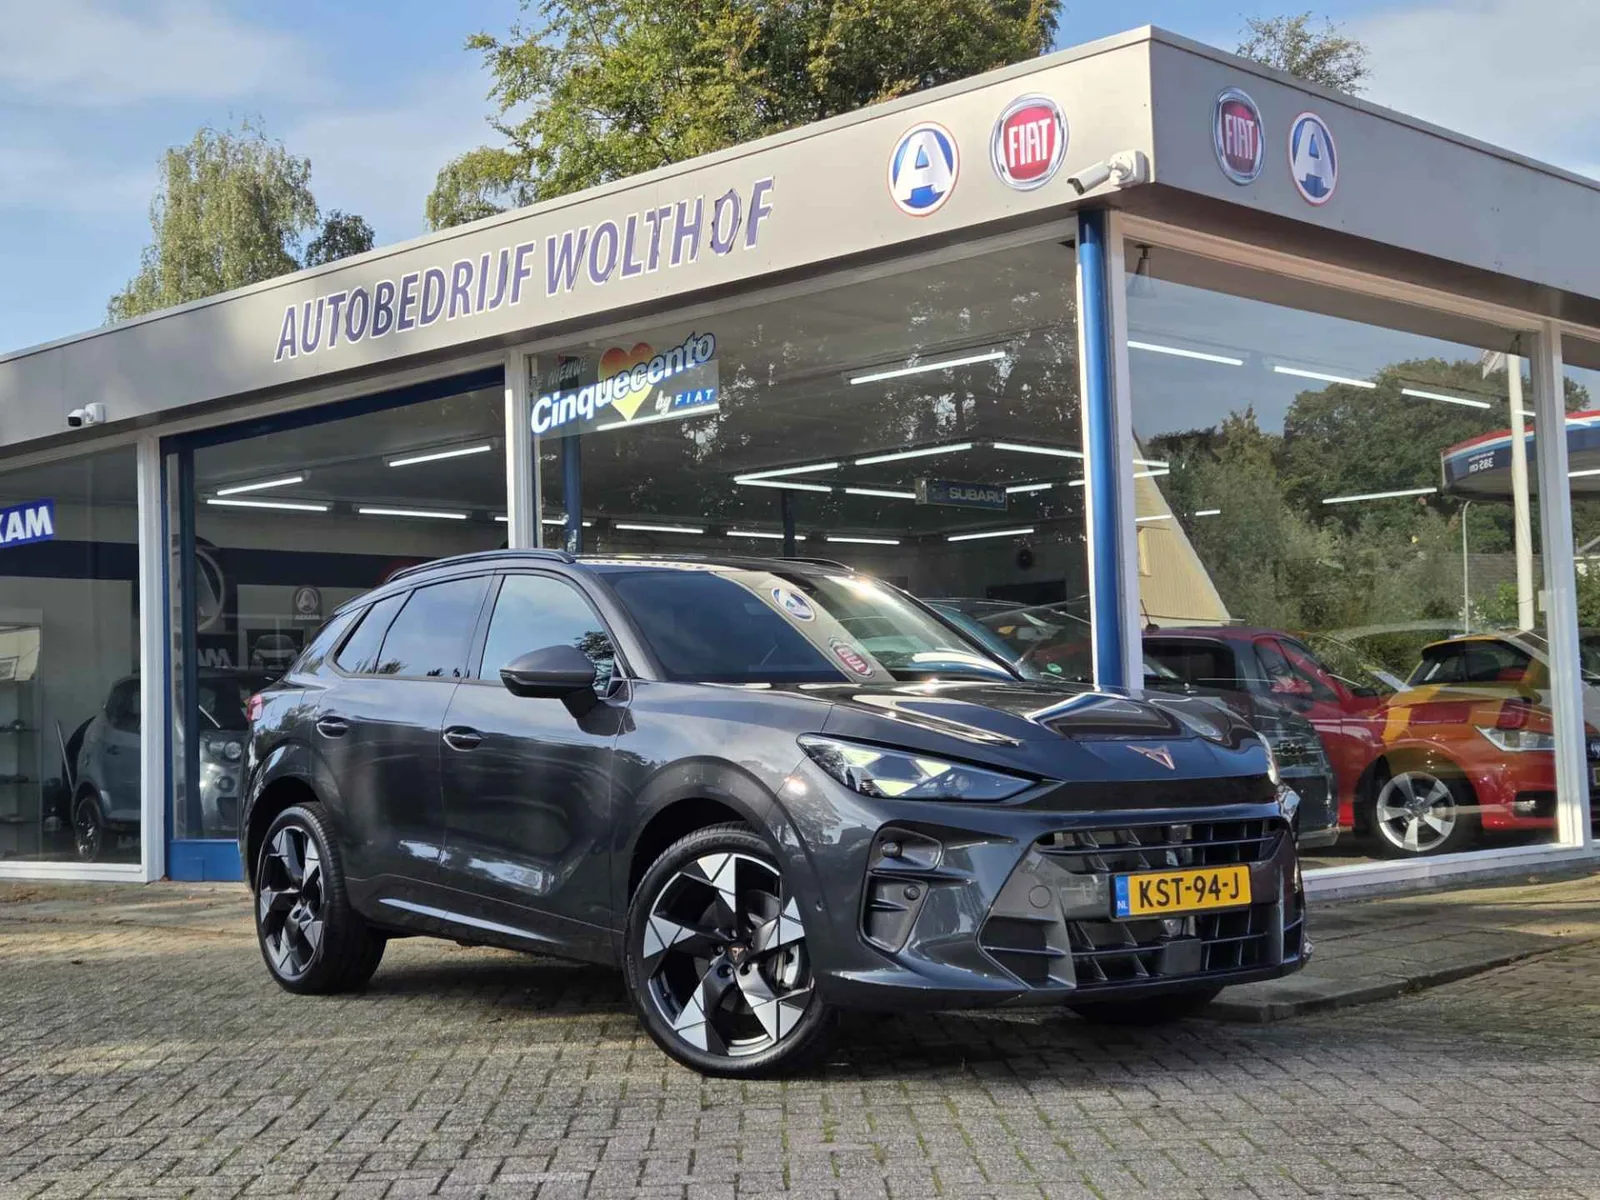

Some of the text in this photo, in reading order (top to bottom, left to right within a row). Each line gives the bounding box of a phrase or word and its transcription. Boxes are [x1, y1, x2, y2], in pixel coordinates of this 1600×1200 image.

[1008, 117, 1051, 169] FIAT
[1224, 112, 1256, 161] FIAT
[273, 176, 776, 363] AUTOBEDRIJF WOLTHOF
[531, 331, 717, 434] Cinquecento
[654, 389, 714, 415] by FIAT
[949, 487, 1005, 503] SUBARU
[0, 505, 53, 543] AM
[1117, 872, 1240, 909] NL KST-94-J
